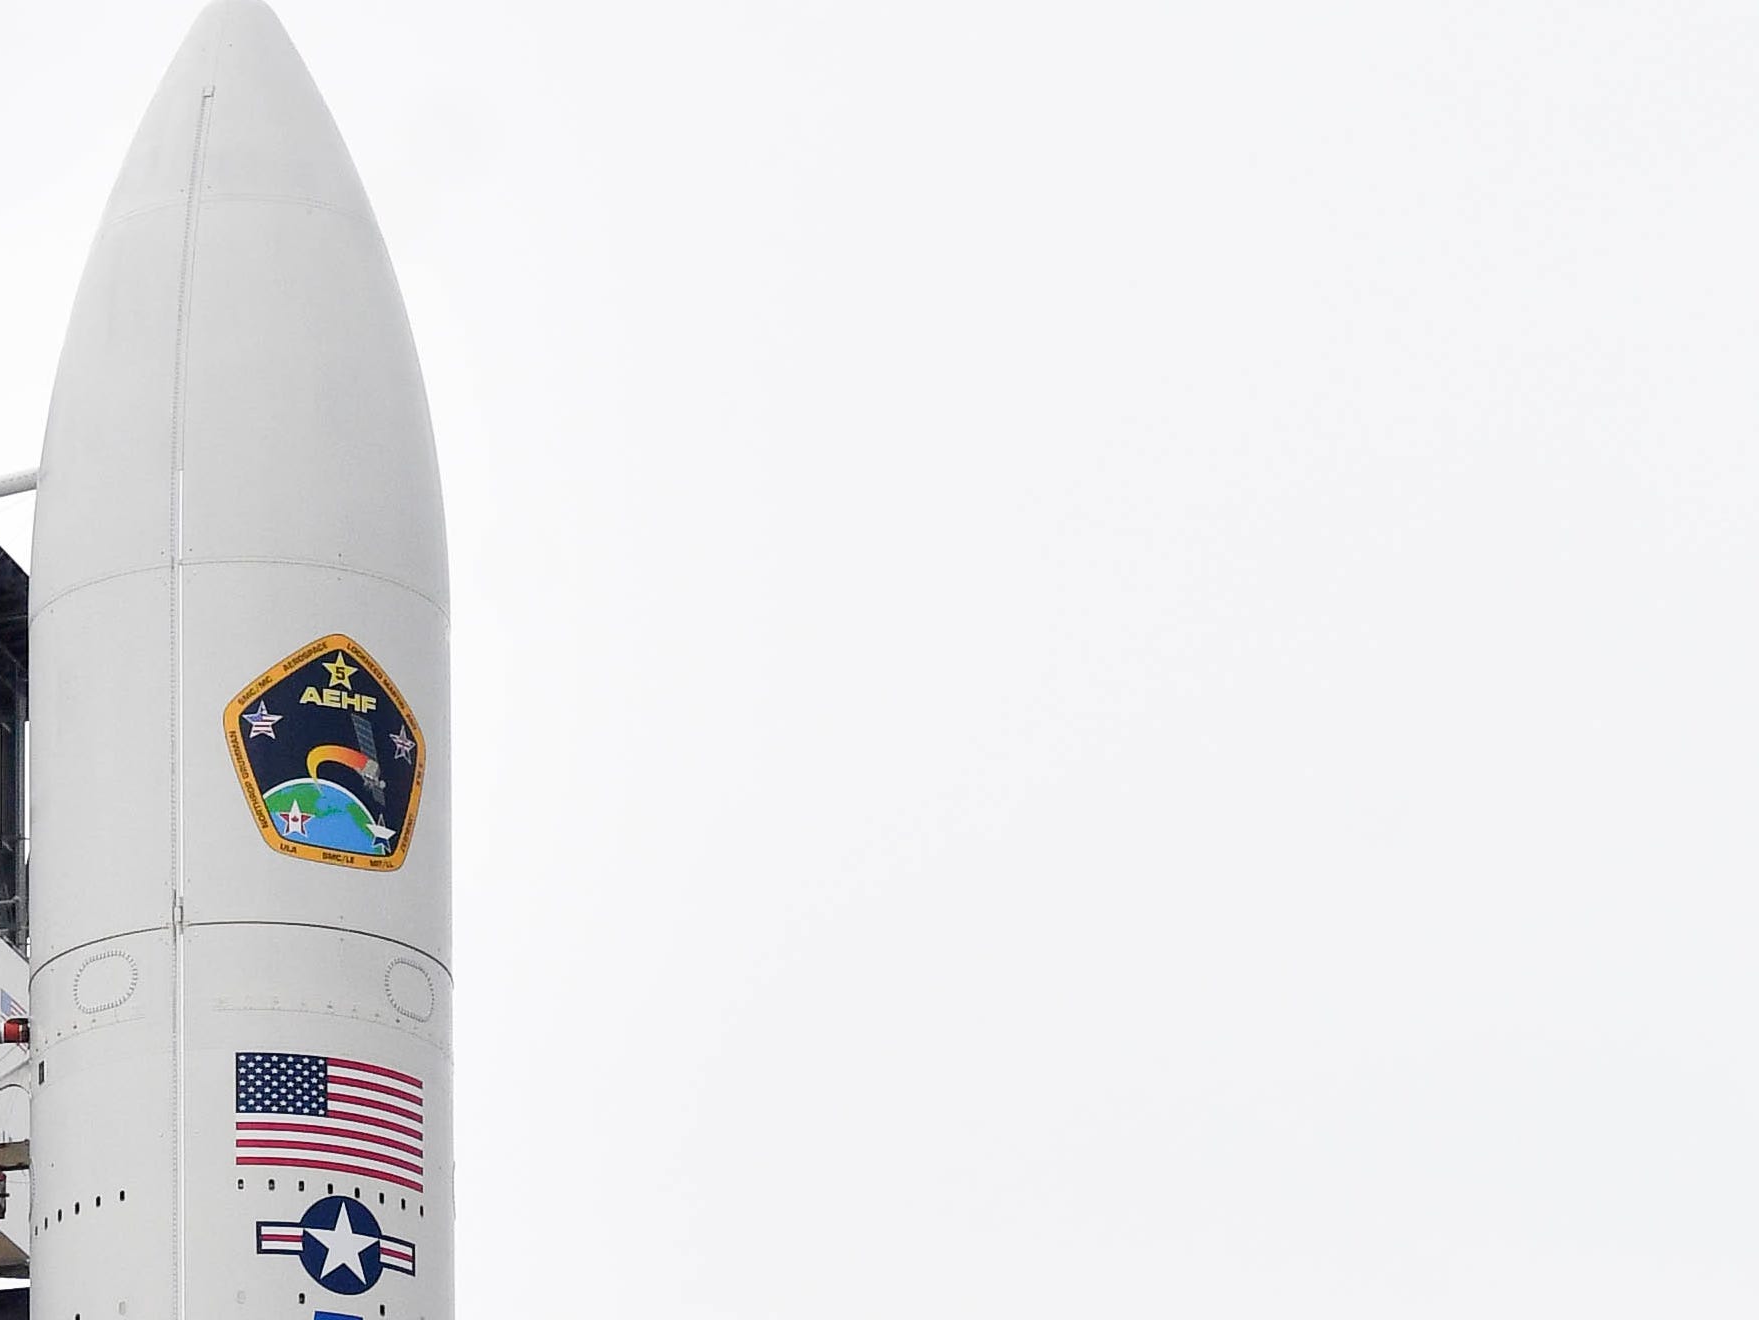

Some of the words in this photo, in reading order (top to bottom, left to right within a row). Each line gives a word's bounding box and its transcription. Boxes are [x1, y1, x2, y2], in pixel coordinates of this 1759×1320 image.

[282, 641, 328, 672] AEROSPACE
[335, 666, 346, 681] 5
[299, 685, 377, 714] AEHF
[245, 781, 269, 829] NORTHROP
[280, 843, 297, 854] ULA
